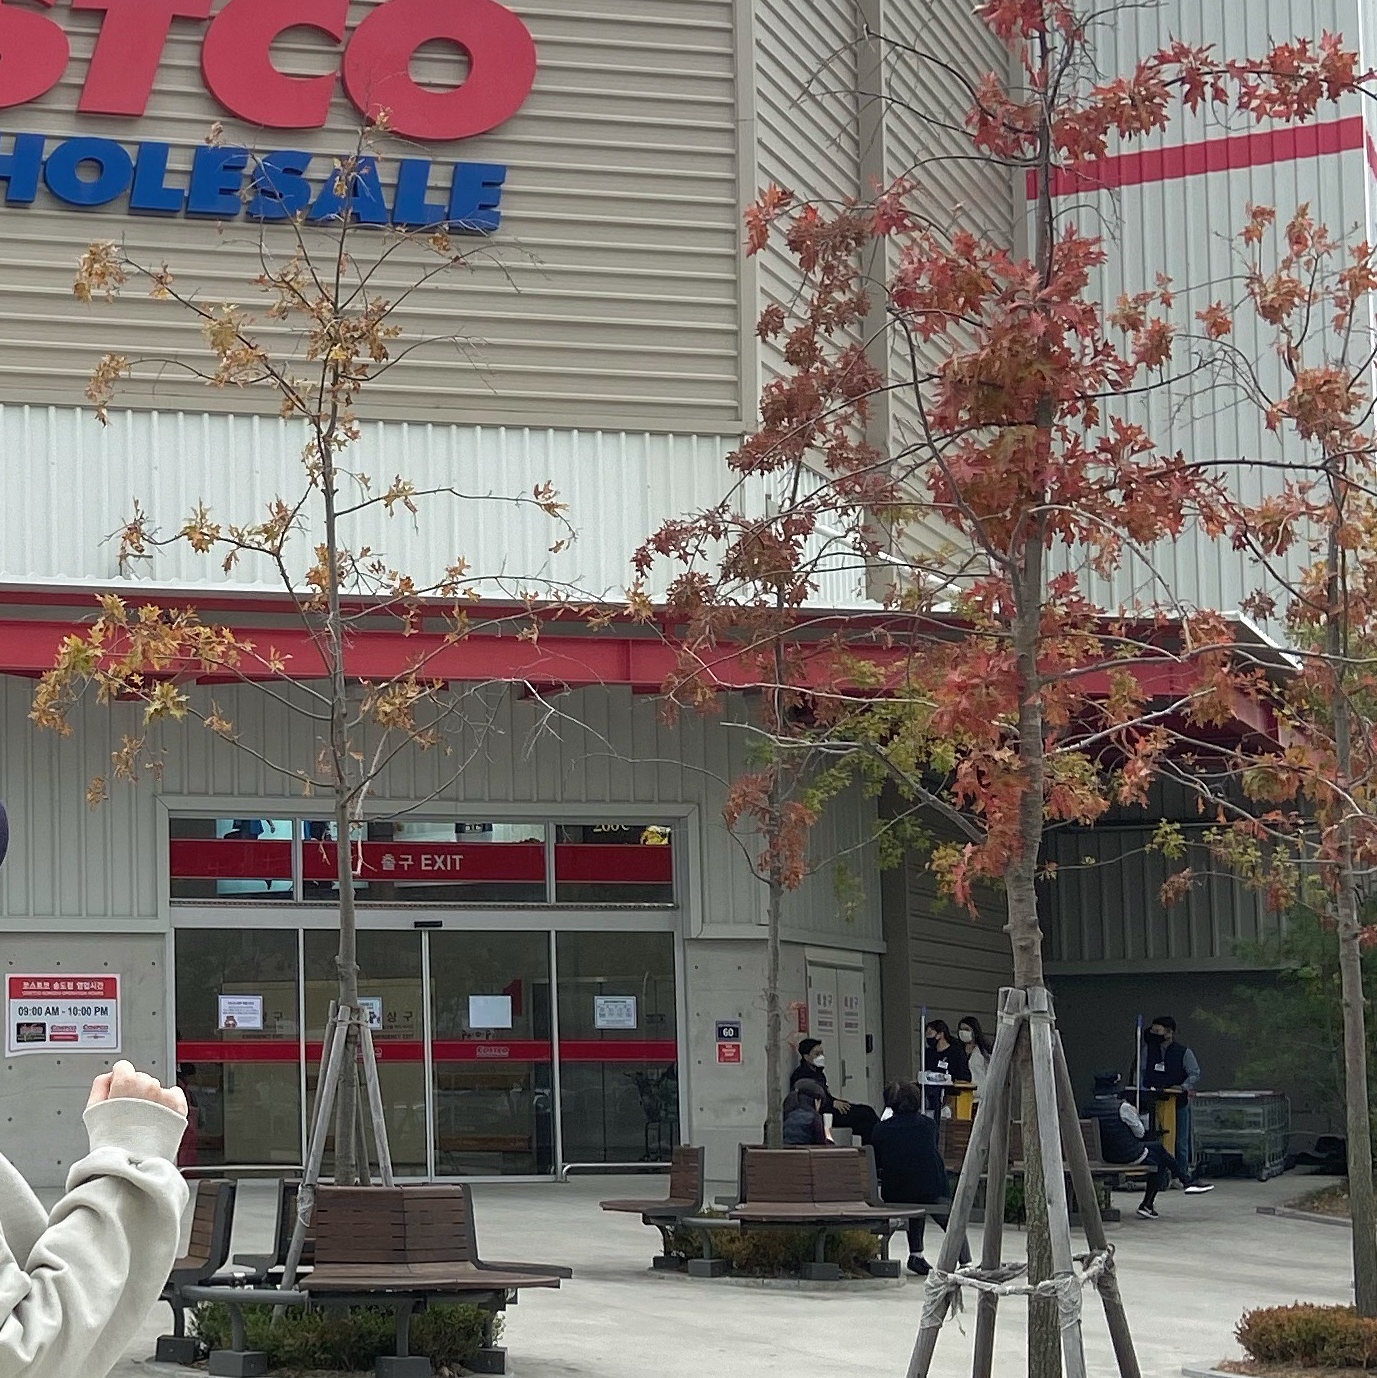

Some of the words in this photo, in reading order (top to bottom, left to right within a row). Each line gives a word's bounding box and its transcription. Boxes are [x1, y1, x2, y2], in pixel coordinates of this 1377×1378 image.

[381, 853, 414, 871] 출구
[421, 854, 464, 871] EXIT
[18, 1006, 42, 1016] 09:00
[45, 1006, 59, 1016] AM
[68, 1006, 92, 1016] 10:00
[94, 1006, 109, 1016] PM
